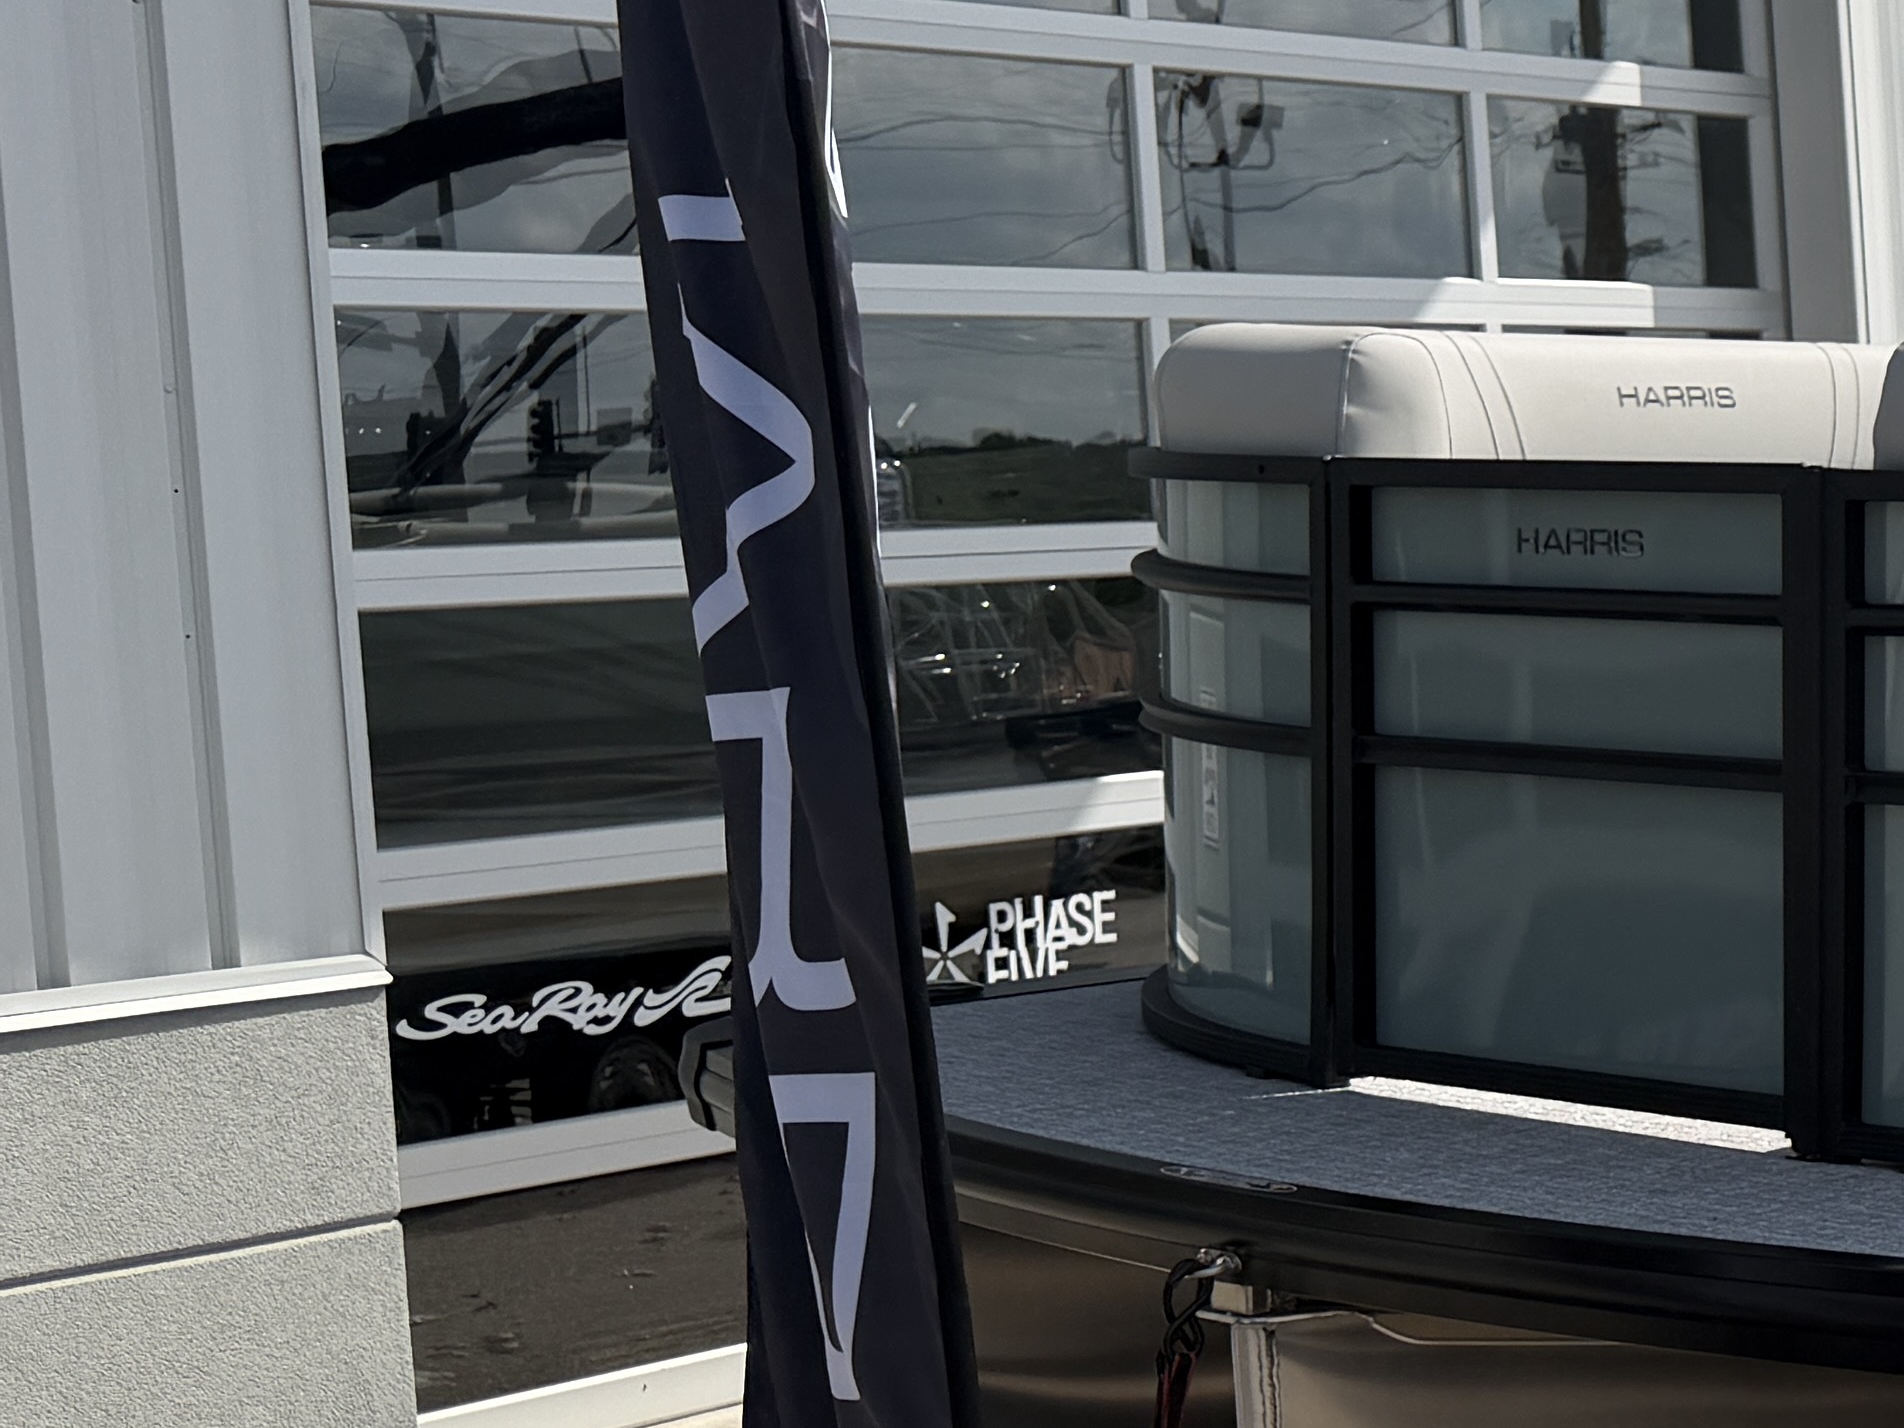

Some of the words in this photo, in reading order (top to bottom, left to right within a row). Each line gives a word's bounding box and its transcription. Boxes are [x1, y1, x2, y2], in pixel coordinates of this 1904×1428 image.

[1616, 385, 1737, 410] HARRIS
[1515, 526, 1645, 558] HARRIS
[988, 888, 1118, 952] PHASE
[986, 941, 1070, 984] FIVE
[395, 992, 528, 1041] Sea
[521, 980, 643, 1037] Ray
